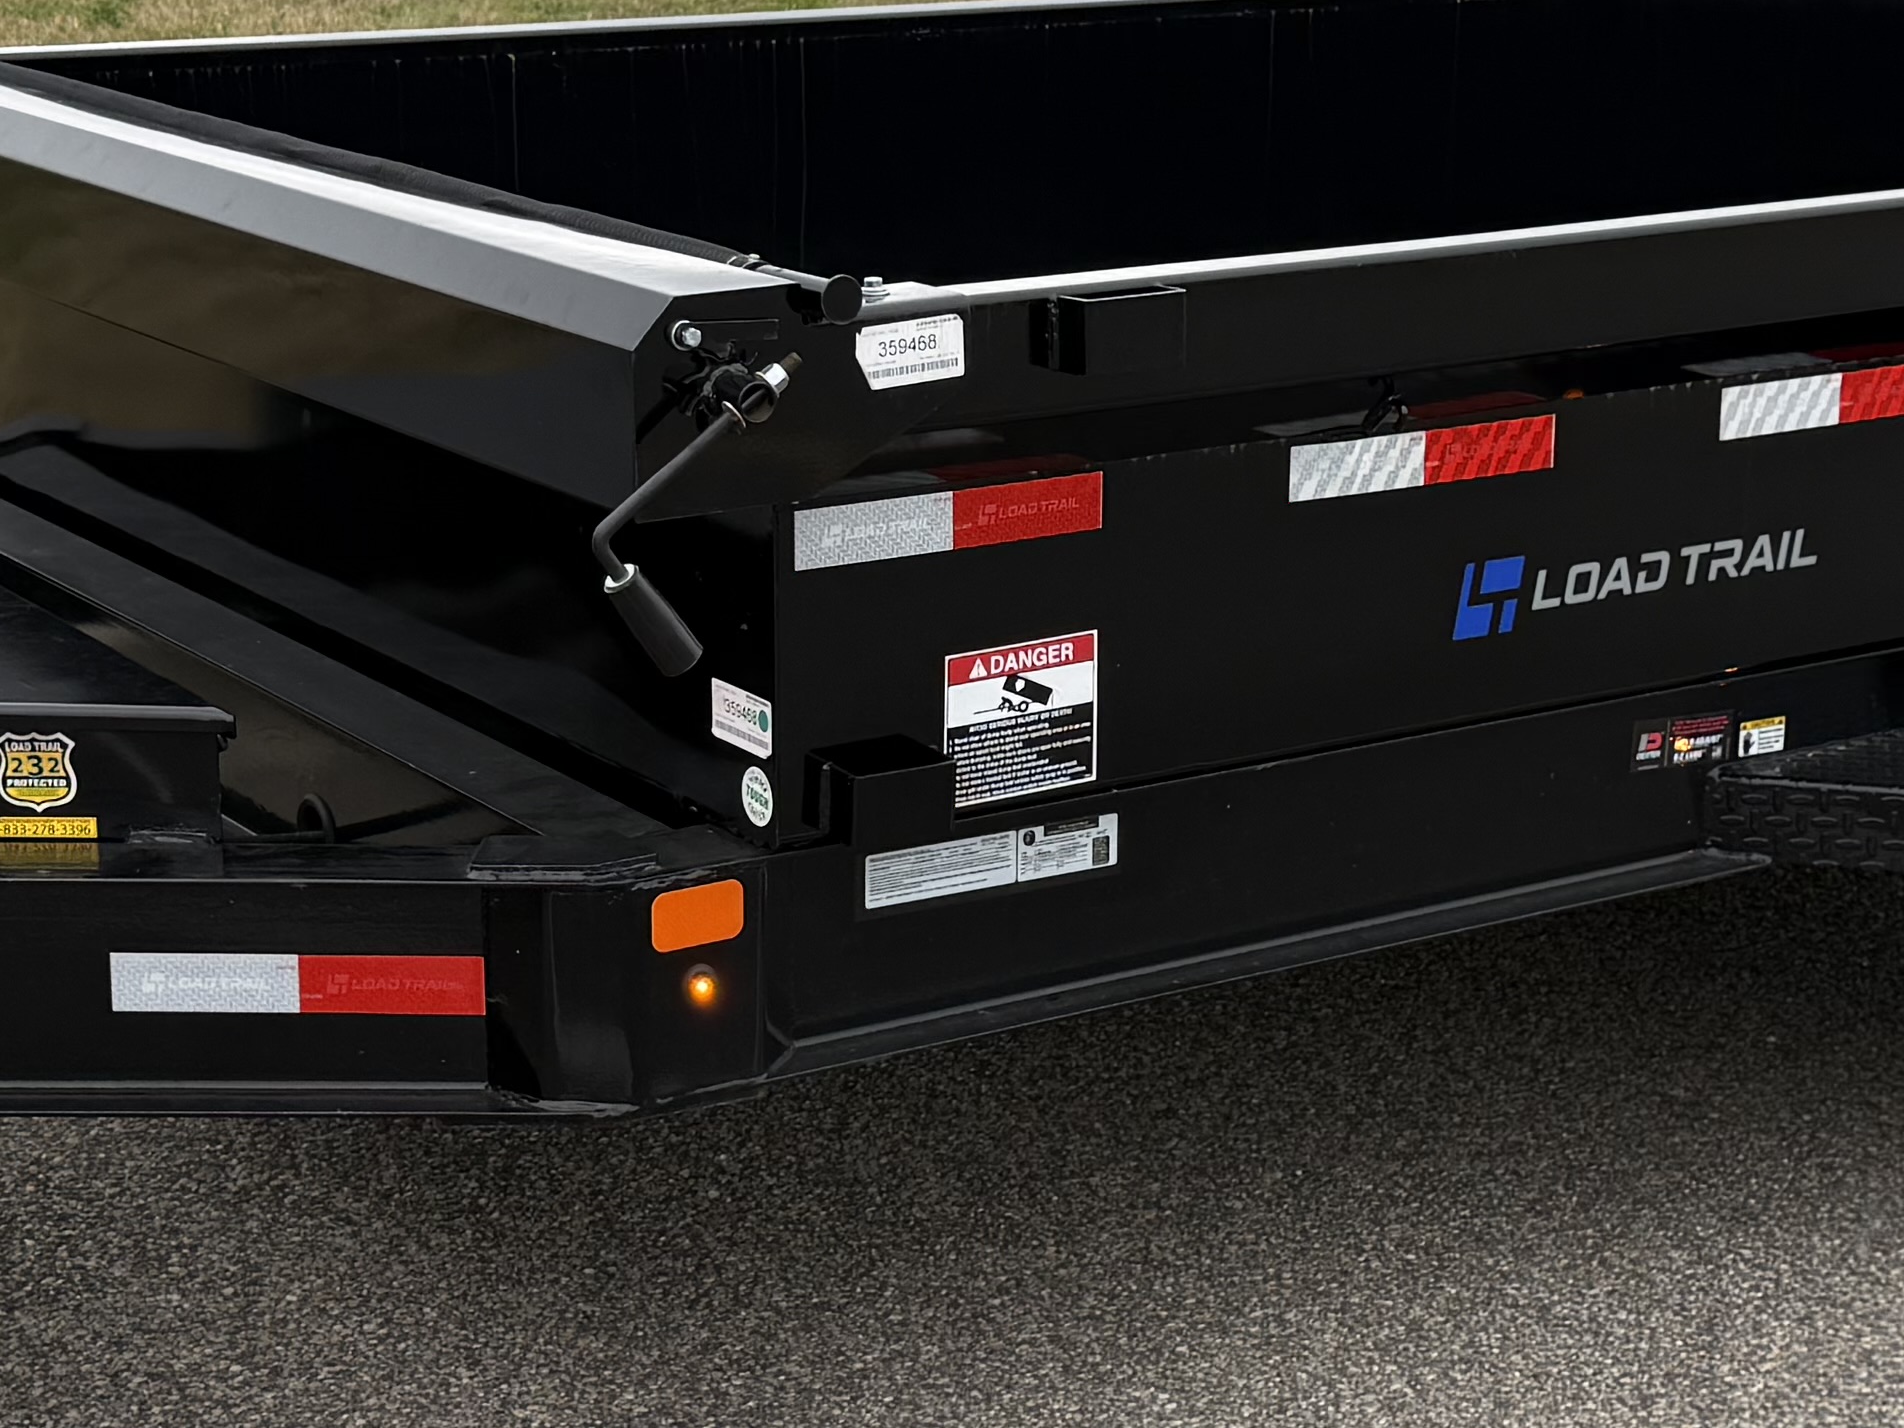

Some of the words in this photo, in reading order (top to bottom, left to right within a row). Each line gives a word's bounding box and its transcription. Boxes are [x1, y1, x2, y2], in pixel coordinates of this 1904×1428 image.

[878, 333, 937, 357] 359468
[999, 503, 1038, 519] LOAD
[1041, 496, 1080, 513] TRAIL
[1531, 550, 1670, 611] LOAD
[1680, 528, 1818, 586] TRAIL
[990, 642, 1074, 675] DANGER
[4, 741, 31, 752] LOAD
[33, 741, 64, 752] TRAIL
[10, 754, 60, 776] 232
[6, 778, 67, 787] PROTECTED
